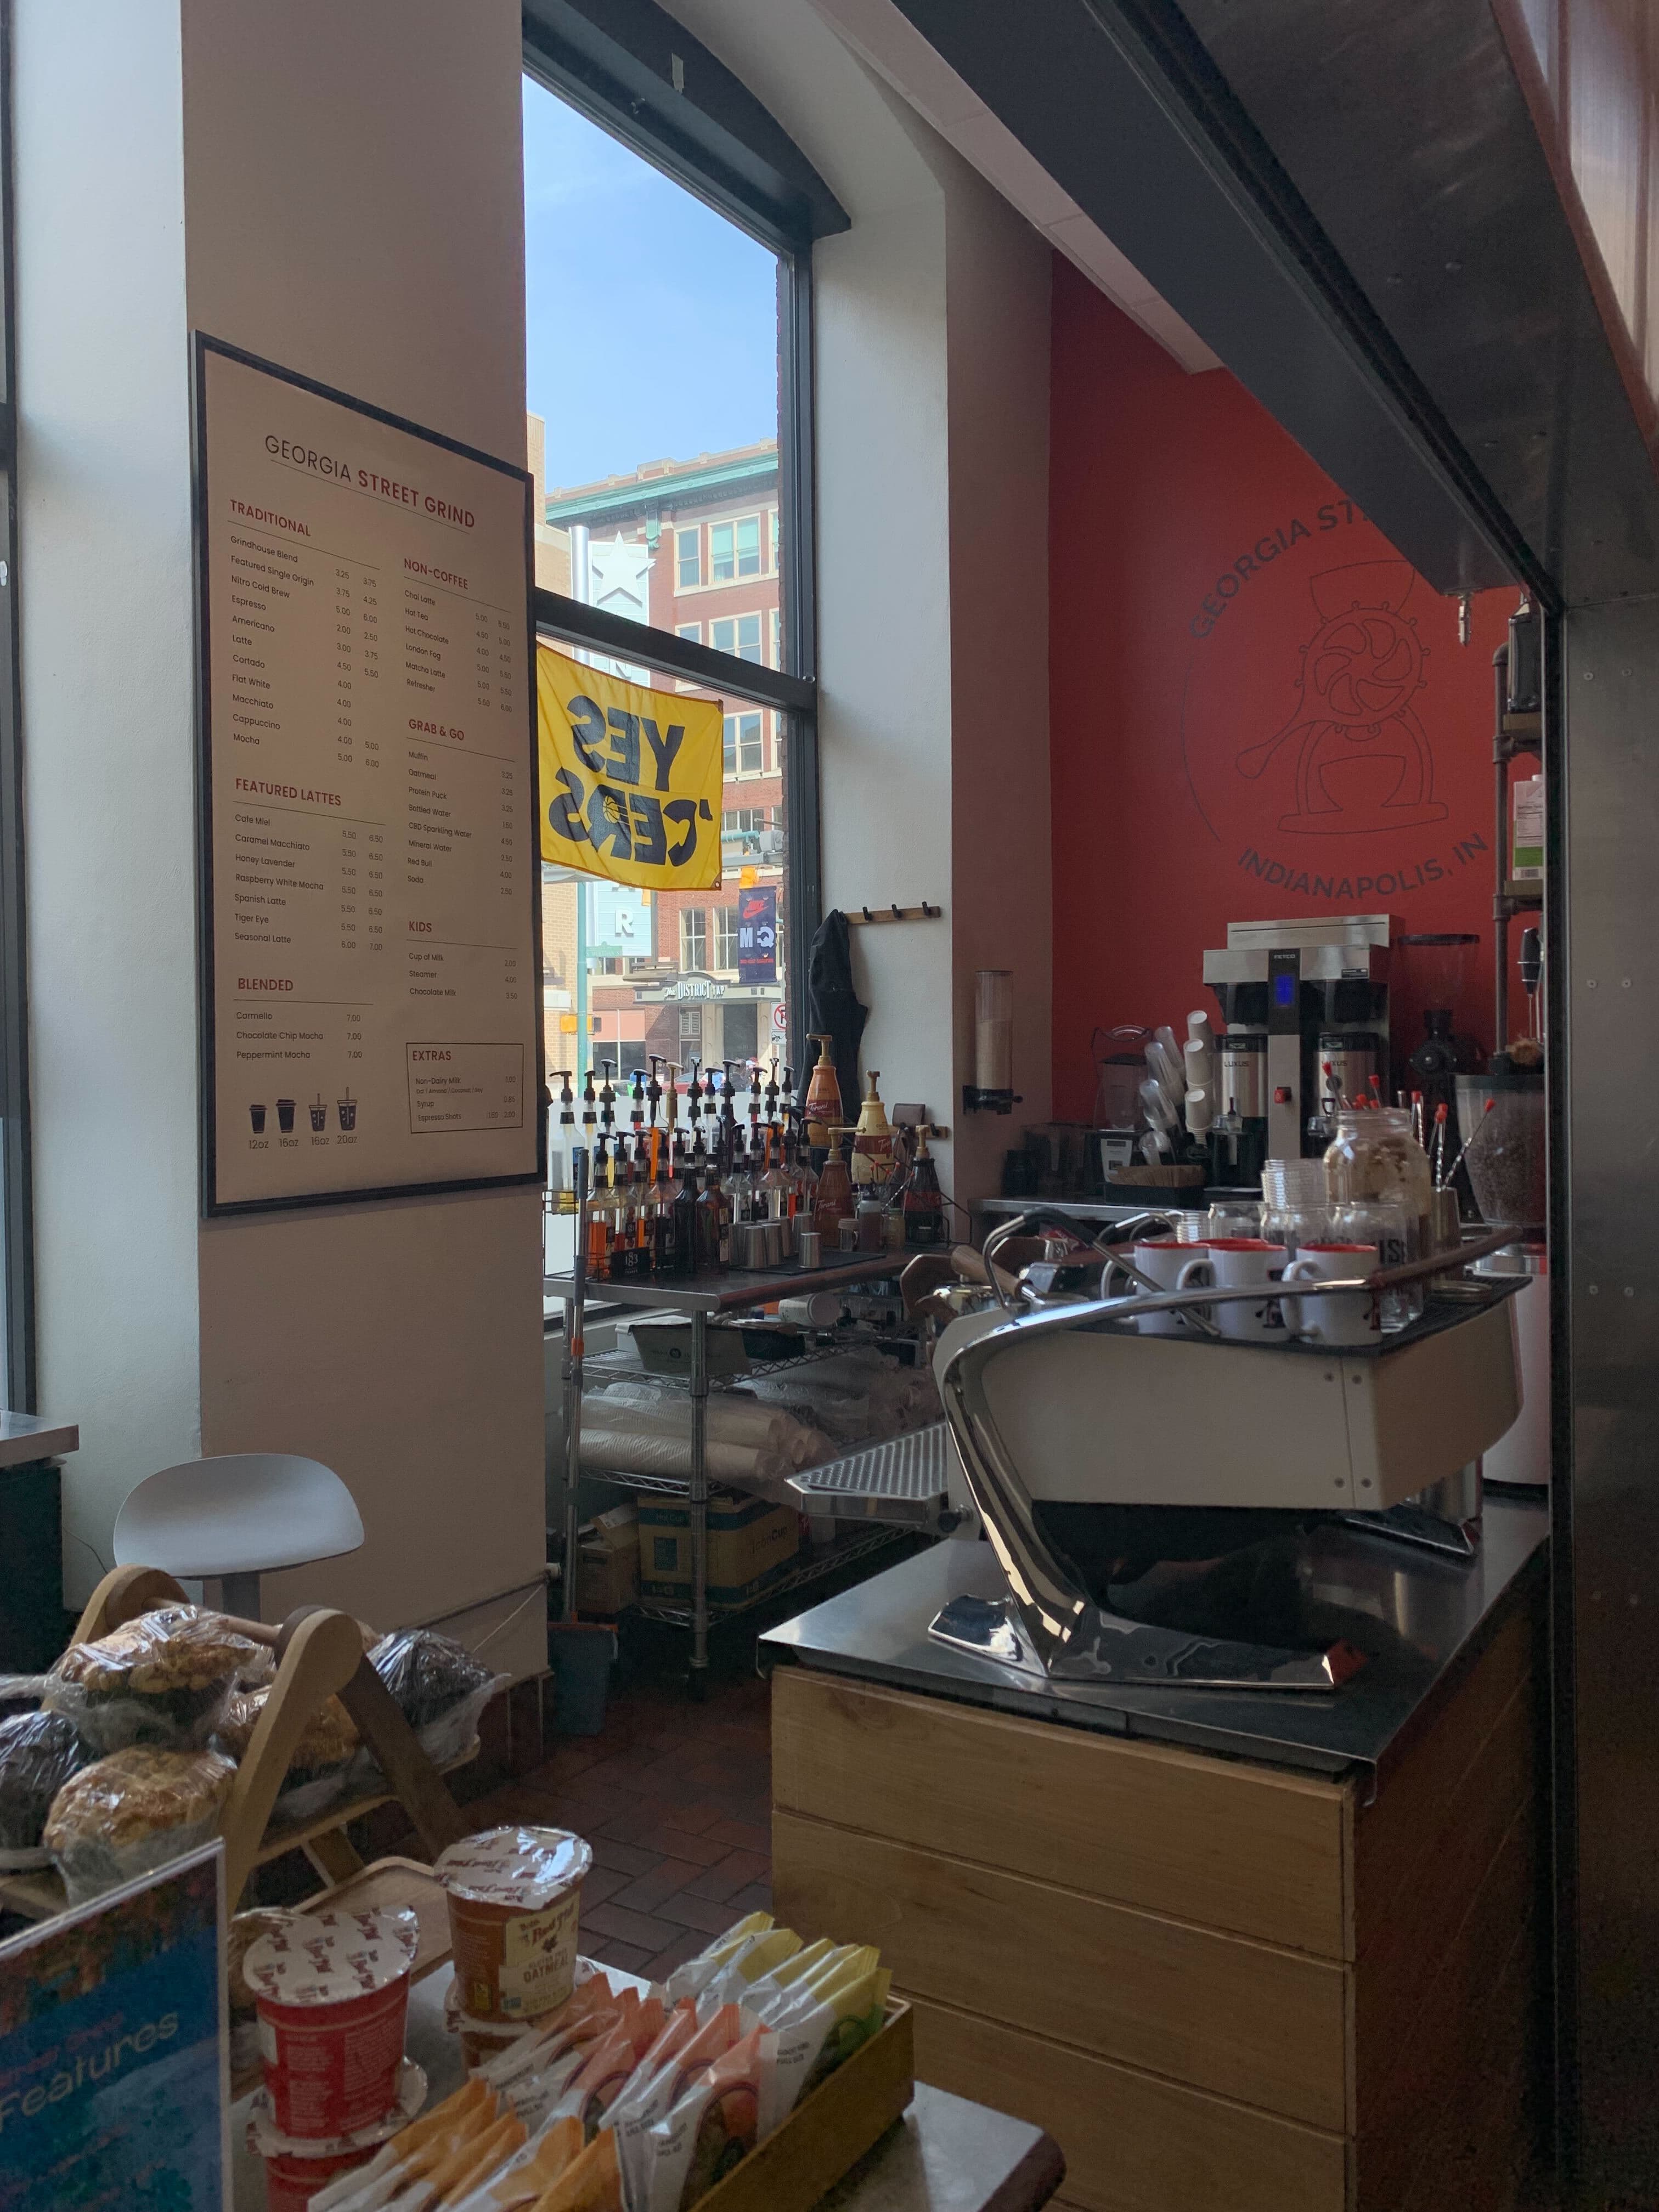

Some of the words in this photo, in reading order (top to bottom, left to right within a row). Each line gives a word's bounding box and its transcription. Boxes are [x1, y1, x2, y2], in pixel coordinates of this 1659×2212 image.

[265, 435, 351, 482] GEORGIA
[358, 470, 419, 507] STREET
[425, 497, 475, 528] GRIND
[230, 499, 311, 537] TRADITIONAL
[231, 536, 275, 555] Grindhouse
[277, 550, 298, 562] Blend
[336, 569, 349, 579] 3.25
[363, 578, 376, 587] 3.75
[232, 555, 266, 572] Featured
[268, 567, 290, 579] Single
[292, 574, 314, 586] Origin
[336, 588, 349, 597] 3.75
[363, 596, 377, 606] 4.25
[404, 558, 468, 590] NON-COFFEE
[1189, 518, 1312, 639] GEORGIA
[232, 575, 250, 586] Nitro
[252, 582, 269, 592] Cold
[272, 587, 290, 598] Brew
[336, 606, 350, 616] 5.00
[363, 613, 377, 623] 6.00
[404, 590, 419, 600] Chai
[421, 595, 435, 606] Latte
[476, 613, 488, 623] 5.00
[232, 595, 266, 611] Espresso
[337, 624, 351, 634] 2.00
[364, 632, 377, 641] 2.50
[405, 608, 415, 617] Hot
[417, 611, 428, 620] Tea
[499, 637, 510, 646] 5.00
[233, 616, 275, 632] Americano
[337, 642, 351, 653] 3.00
[365, 650, 378, 660] 3.75
[233, 635, 252, 645] Latte
[405, 625, 416, 634] Hot
[417, 629, 449, 644] Chocolate
[476, 647, 489, 656] 4.00
[406, 643, 428, 655] London
[430, 650, 441, 661] Fog
[477, 664, 489, 673] 5.00
[233, 654, 265, 668] Cortado
[338, 680, 351, 689] 4.00
[406, 662, 428, 673] Matcha
[430, 668, 445, 678] Latte
[477, 681, 489, 690] 5.00
[233, 674, 246, 684] Flat
[249, 678, 270, 689] White
[337, 699, 351, 708] 4.00
[407, 679, 435, 692] Refresher
[233, 694, 273, 709] Macchiato
[338, 718, 352, 726] 4.00
[233, 714, 280, 730] Cappuccino
[337, 736, 352, 744] 4.00
[365, 741, 379, 751] 5.00
[409, 719, 437, 734] GRAB
[439, 726, 447, 736] &
[449, 729, 464, 741] GO
[234, 733, 259, 744] Mocha
[338, 753, 352, 763] 5.00
[365, 759, 379, 768] 6.00
[409, 751, 428, 760] Muffin
[409, 769, 436, 780] Oatmeal
[236, 778, 297, 798] FEATURED
[301, 789, 341, 806] LATTES
[409, 787, 430, 796] Protein
[235, 814, 253, 823] Cafe
[256, 817, 270, 826] Miel
[409, 804, 431, 814] Bottled
[432, 809, 451, 817] Water
[423, 825, 453, 837] Sparkling
[454, 830, 471, 838] Water
[235, 834, 268, 845] Caramel
[270, 839, 309, 850] Macchiato
[409, 840, 431, 849] Mineral
[236, 854, 259, 865] Honey
[261, 857, 295, 867] Lavender
[1237, 847, 1453, 900] INDIANAPOLIS,
[1452, 832, 1489, 866] IN
[236, 873, 274, 887] Raspberry
[276, 878, 297, 887] White
[299, 881, 323, 890] Mocha
[235, 894, 265, 904] Spanish
[267, 897, 286, 905] Latte
[369, 907, 382, 916] 6.50
[748, 900, 765, 911] NIKE
[235, 913, 253, 923] Tiger
[256, 915, 269, 924] Eye
[409, 921, 432, 932] KIDS
[616, 909, 635, 937] R
[235, 933, 270, 941] Seasonal
[409, 953, 422, 962] Cup
[238, 978, 293, 991] BLENDED
[664, 985, 676, 998] The
[678, 980, 712, 1000] DISTRICT
[713, 985, 725, 996] TAP
[279, 1032, 297, 1041] Chip
[237, 1051, 283, 1060] Peppermint
[413, 1051, 451, 1060] EXTRAS
[417, 1101, 434, 1109] Syrup
[809, 1102, 829, 1114] Torani
[249, 1139, 268, 1149] 12oz
[279, 1138, 298, 1147] 16oz
[311, 1136, 329, 1145] 16oz
[337, 1135, 357, 1144] 20oz
[817, 1199, 837, 1214] Torani
[523, 1955, 568, 1983] OATMEAL
